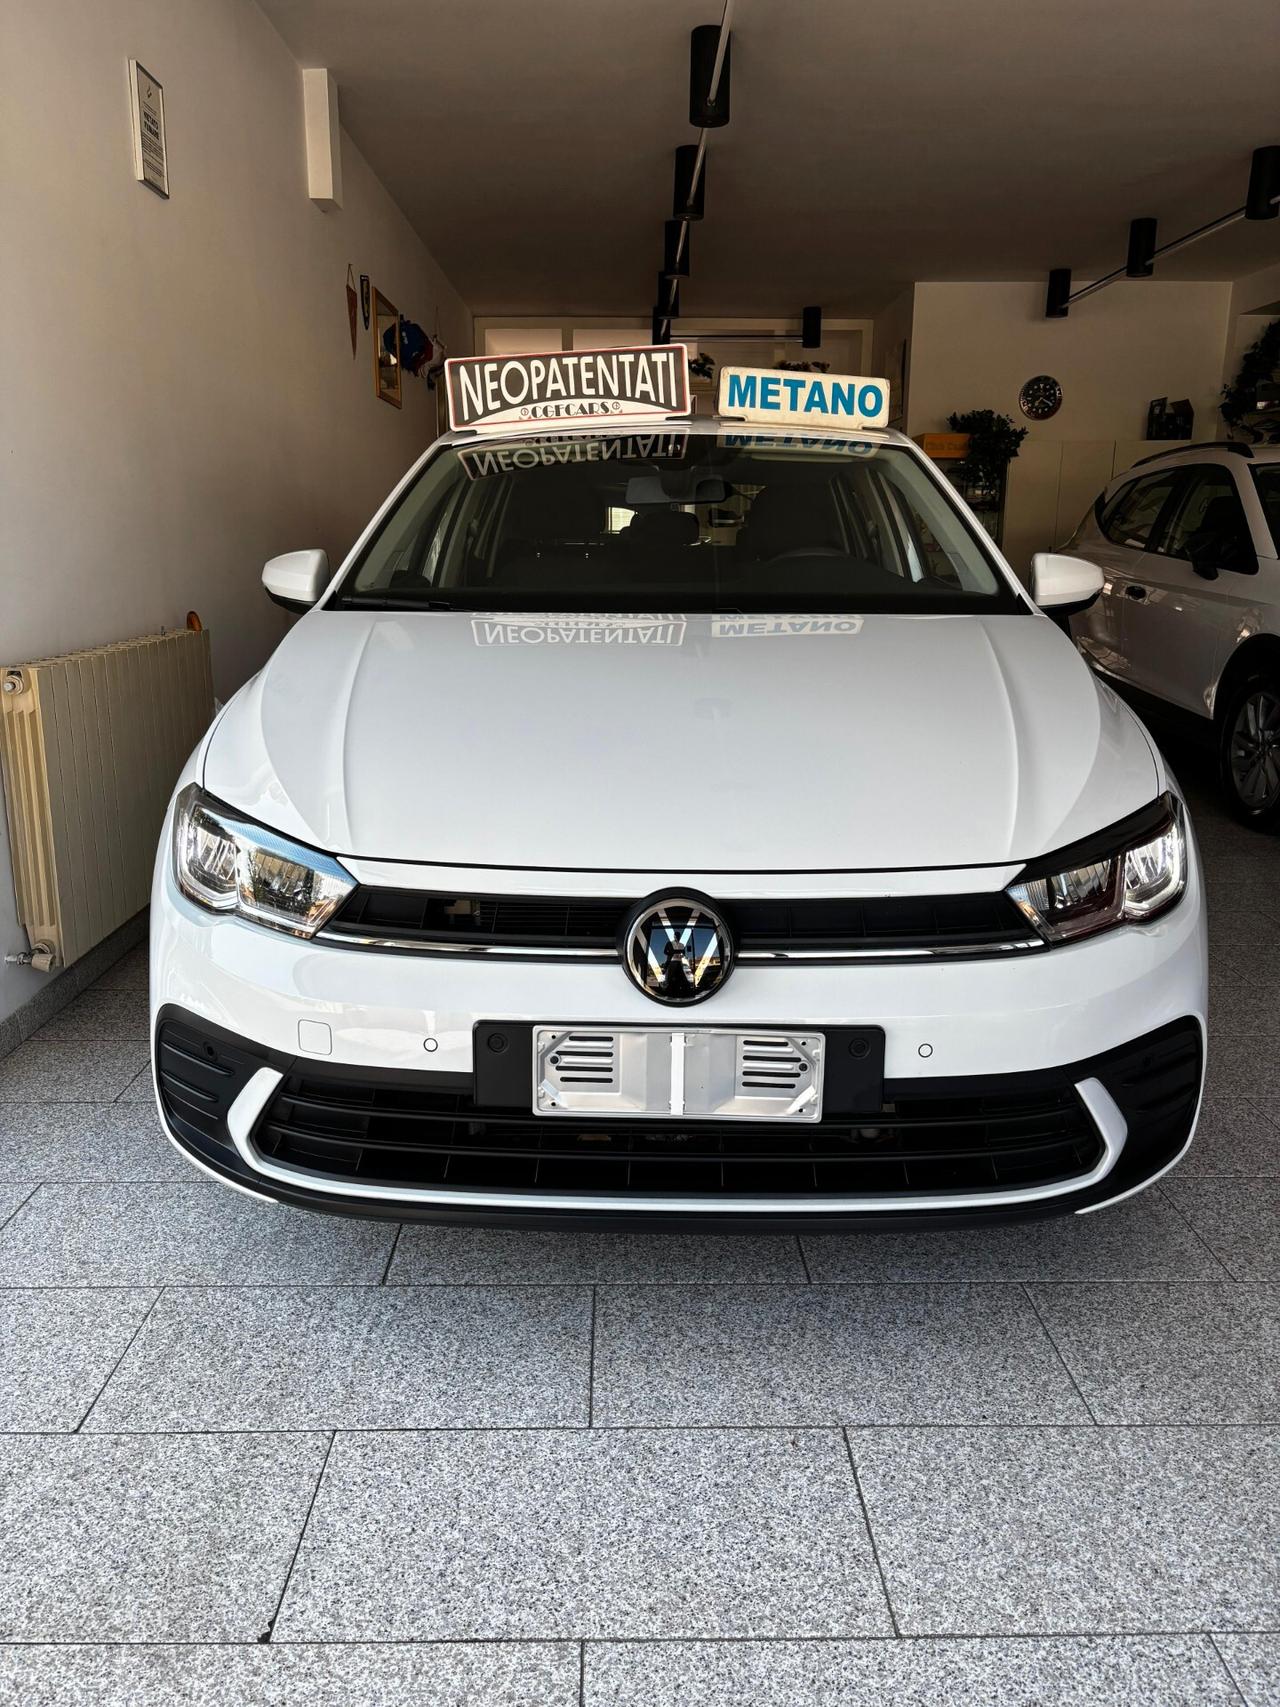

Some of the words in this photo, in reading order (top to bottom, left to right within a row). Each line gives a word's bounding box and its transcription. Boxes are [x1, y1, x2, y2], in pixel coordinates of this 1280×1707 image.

[459, 352, 677, 421] NEOPATENTATI
[727, 374, 884, 418] METANO
[531, 401, 610, 418] CGFCARS
